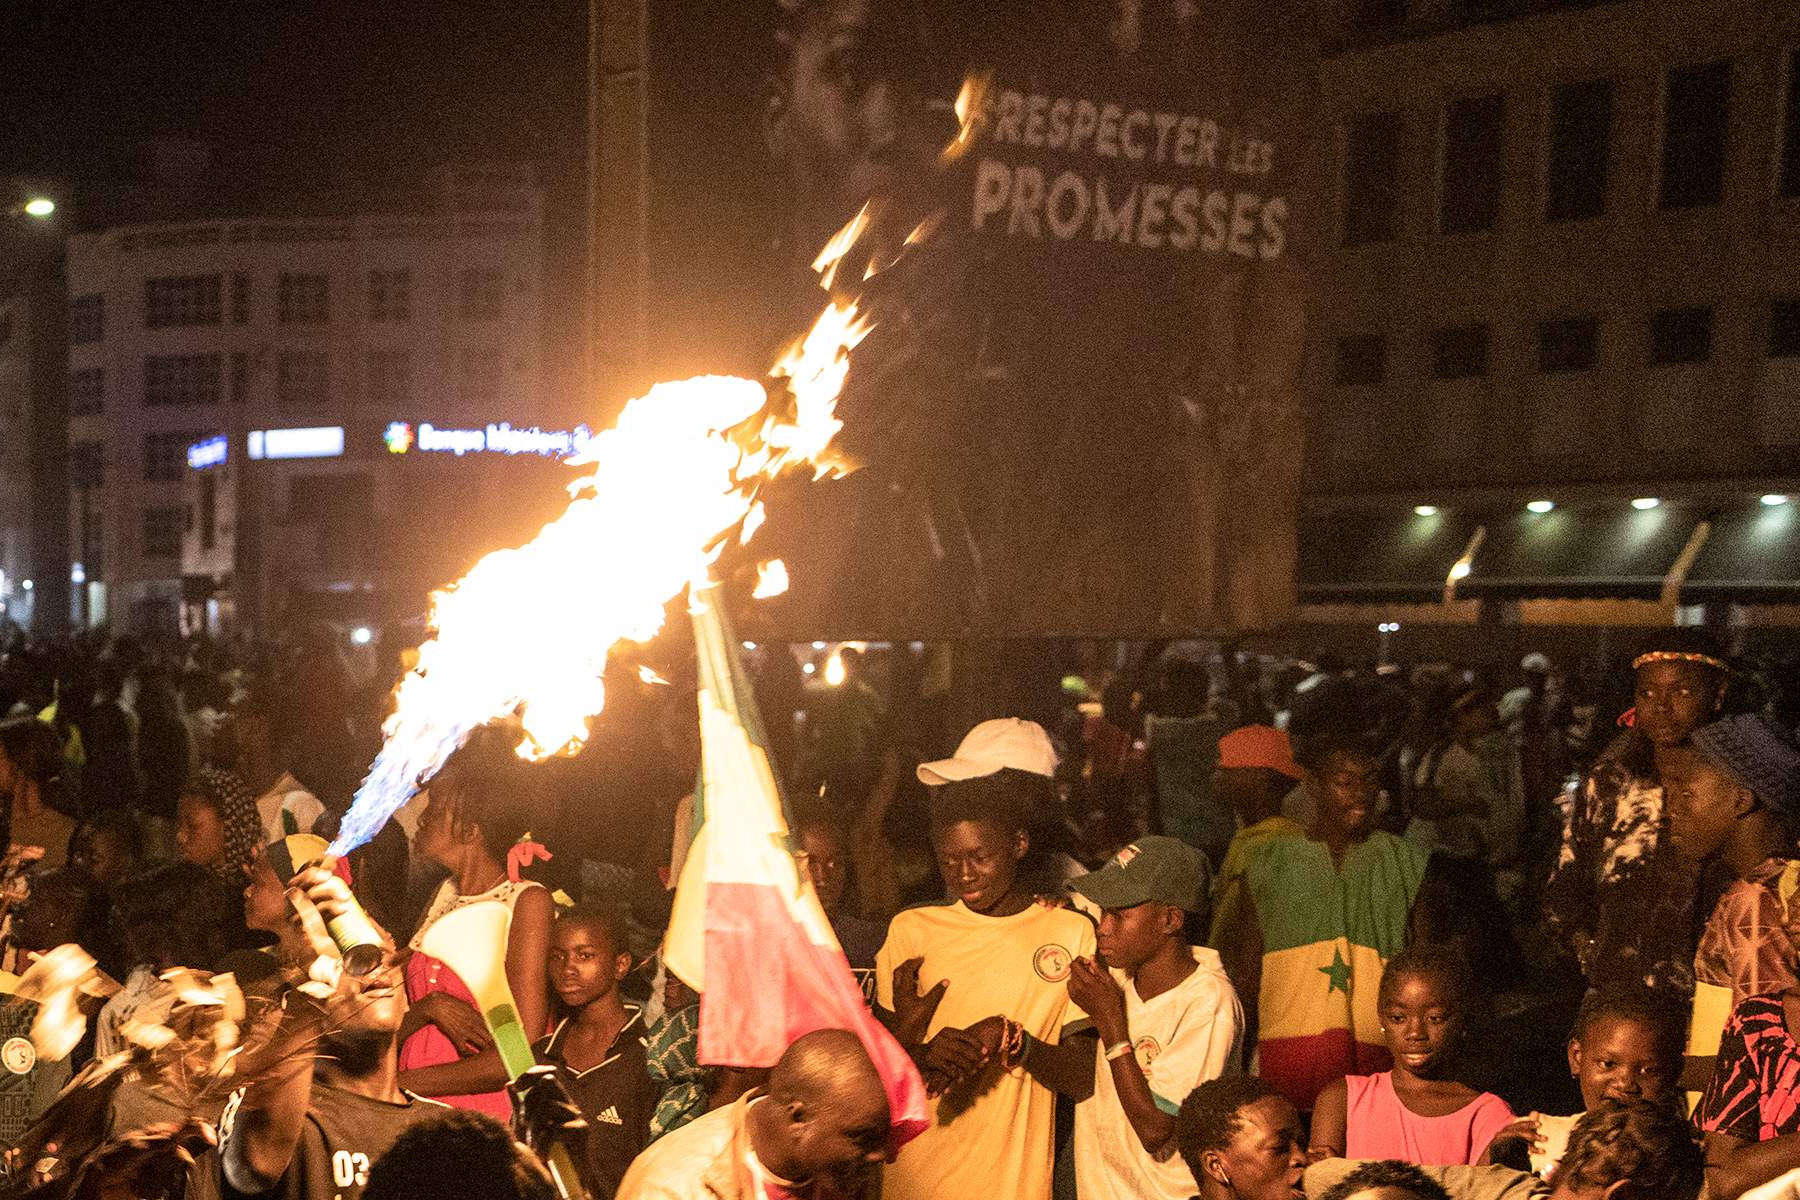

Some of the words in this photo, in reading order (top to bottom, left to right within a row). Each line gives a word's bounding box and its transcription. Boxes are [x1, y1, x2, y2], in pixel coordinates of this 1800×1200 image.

[995, 90, 1218, 168] RESPECTER
[1228, 139, 1275, 174] LES
[972, 157, 1288, 260] PROMESSES
